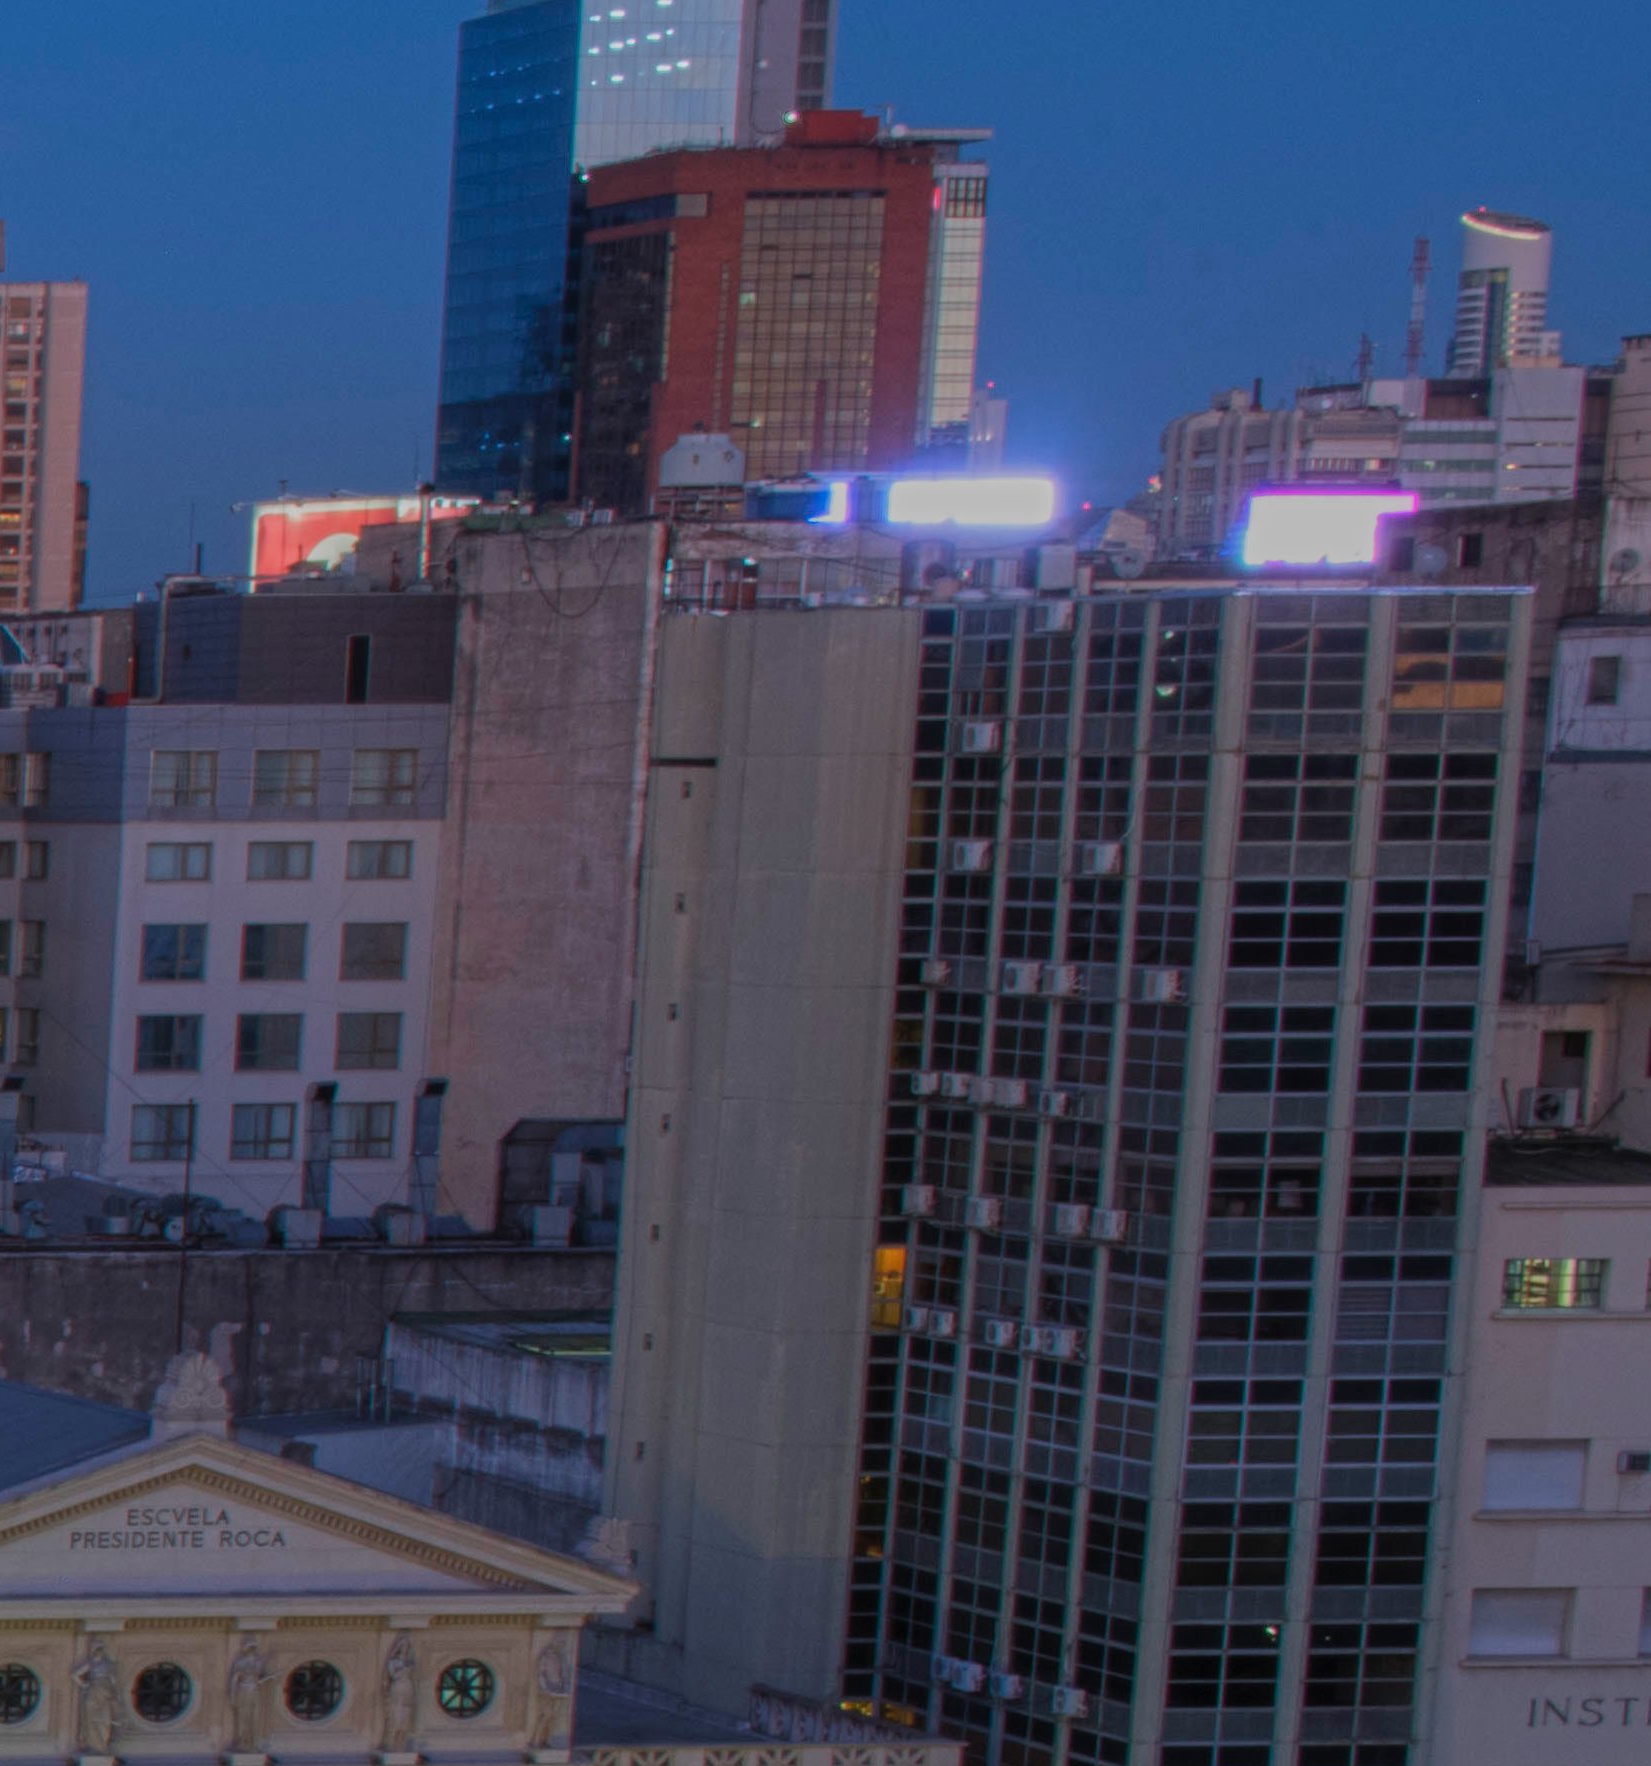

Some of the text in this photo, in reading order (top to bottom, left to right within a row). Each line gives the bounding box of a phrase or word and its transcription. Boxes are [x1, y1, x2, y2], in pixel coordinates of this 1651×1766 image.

[127, 1508, 229, 1526] ESCVELA
[70, 1530, 285, 1549] PRESIDENTE ROCA
